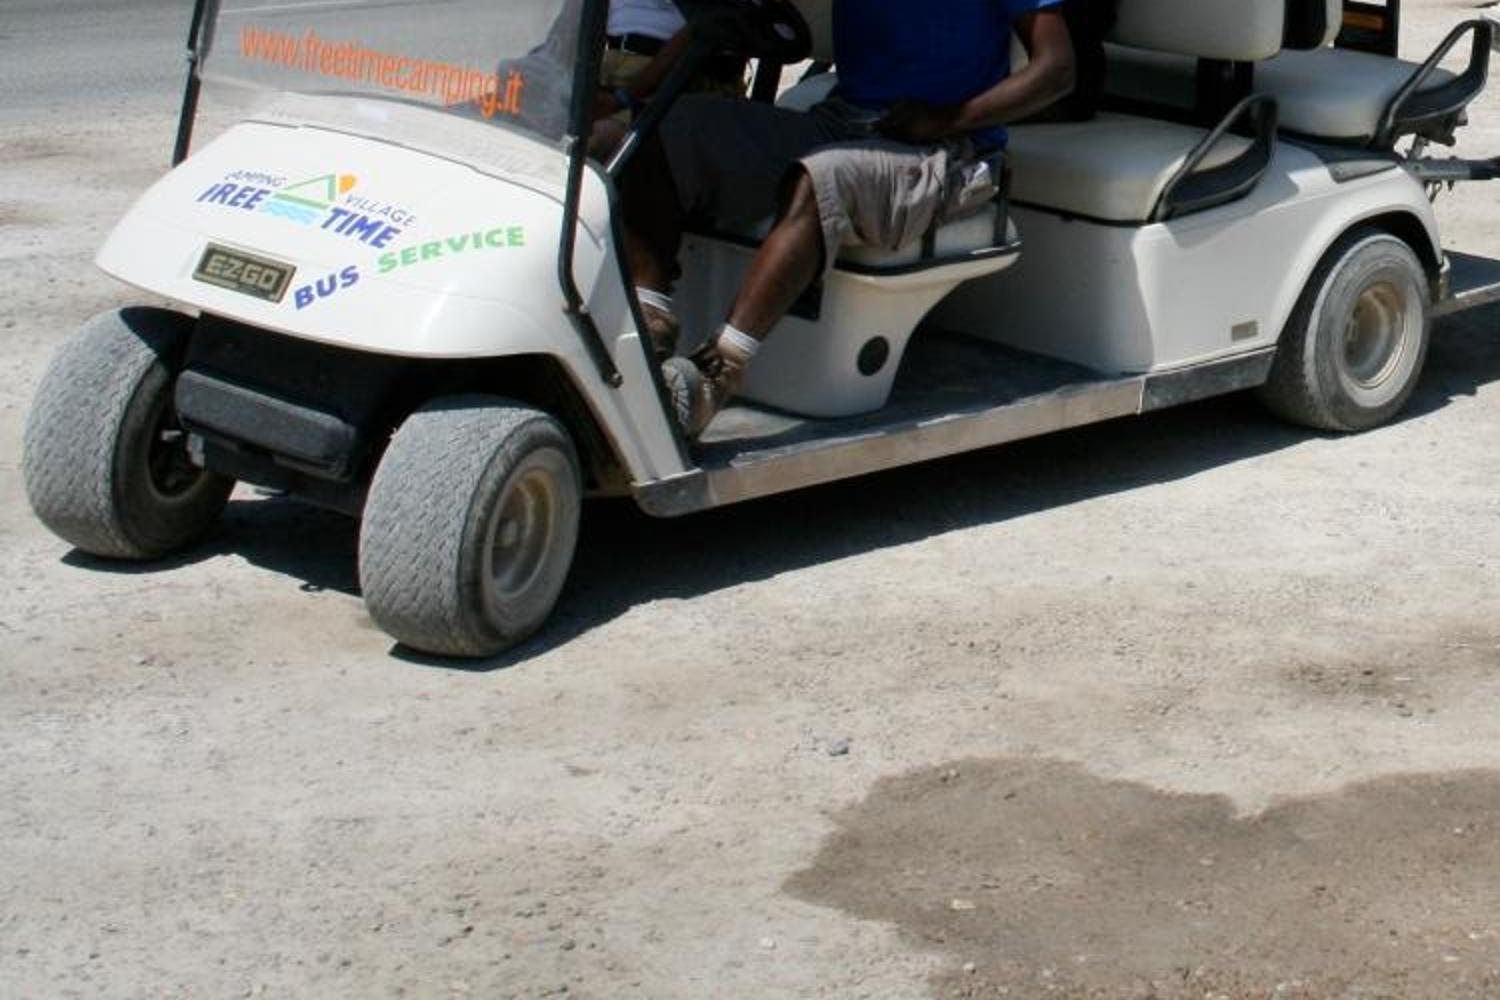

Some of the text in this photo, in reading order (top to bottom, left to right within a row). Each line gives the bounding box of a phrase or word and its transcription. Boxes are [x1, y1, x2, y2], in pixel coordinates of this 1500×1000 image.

[240, 24, 524, 118] www.freetimecamping.it
[321, 206, 402, 249] TIME
[347, 194, 416, 227] VILLAGE
[294, 226, 525, 310] BUS SERVICE
